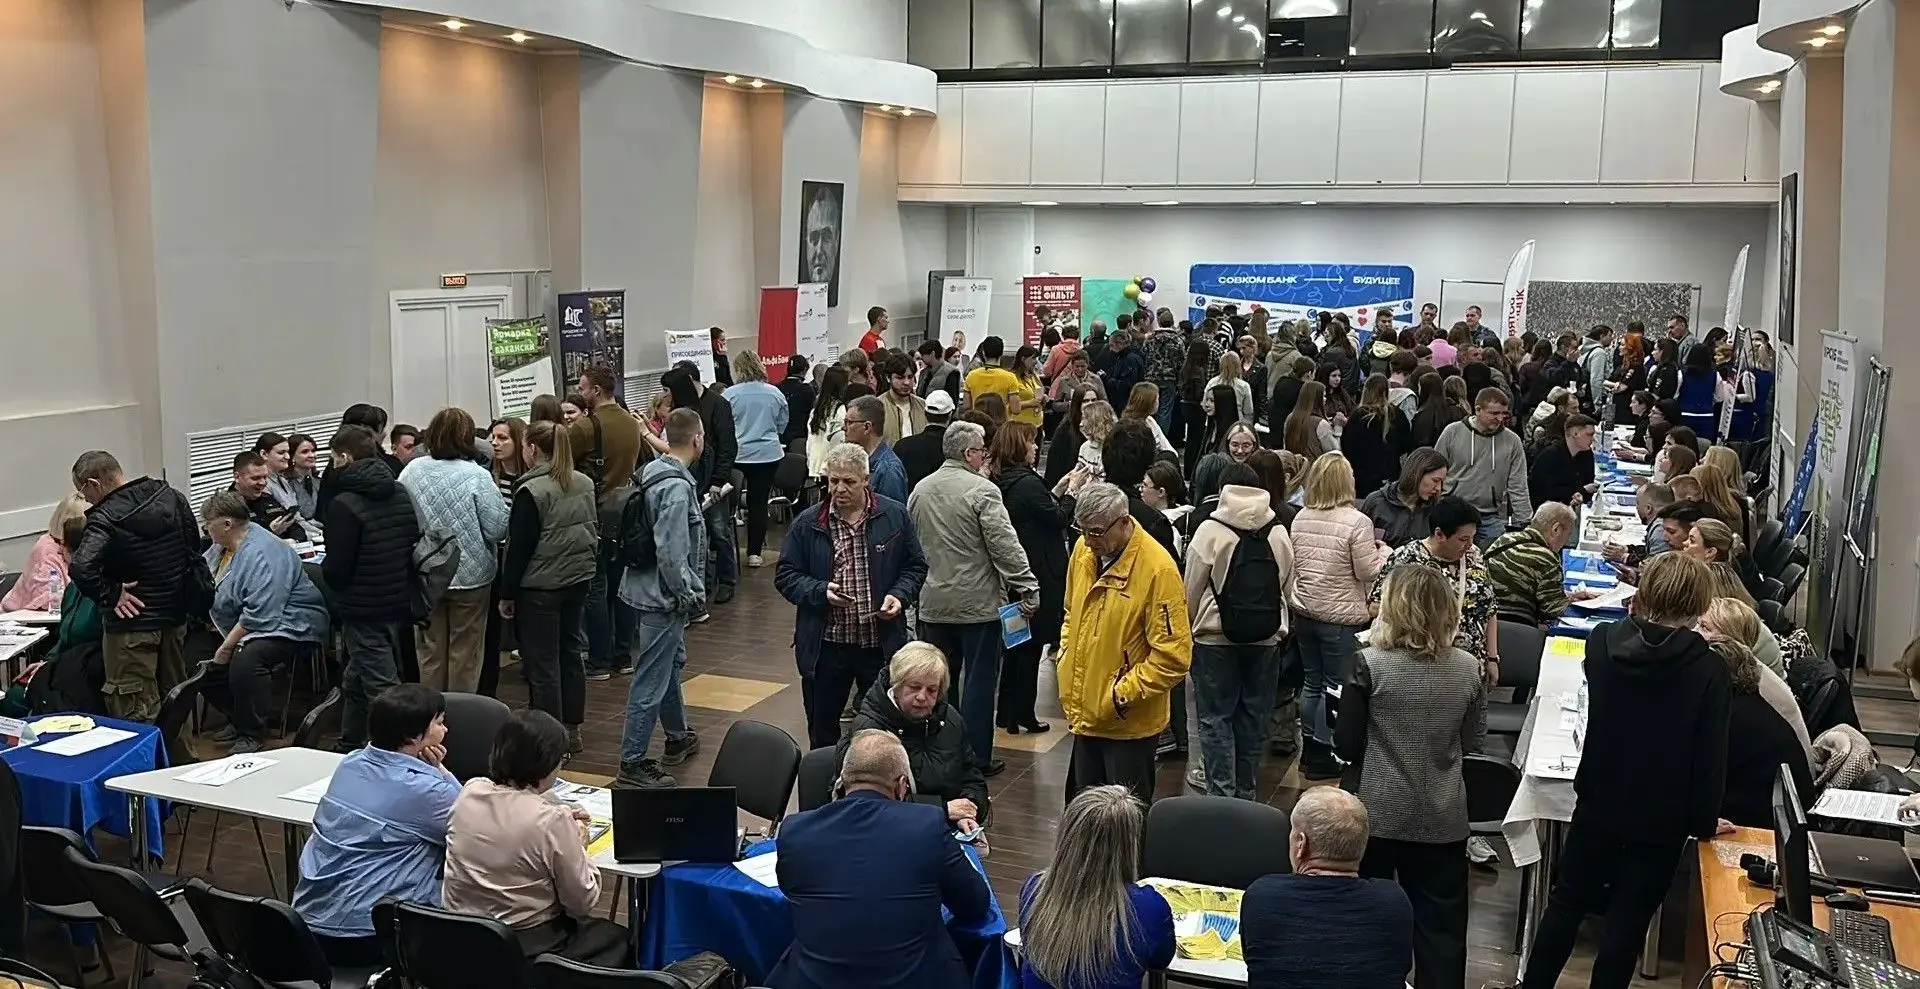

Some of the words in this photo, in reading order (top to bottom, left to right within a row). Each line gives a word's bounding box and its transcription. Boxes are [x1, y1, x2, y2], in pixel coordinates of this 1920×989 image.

[1218, 276, 1297, 284] СОВКОМБАНК
[1353, 276, 1400, 285] БУДУЩЕЕ
[1043, 291, 1075, 299] ФИЛЬТР
[493, 328, 532, 341] Ярмарка
[495, 339, 536, 354] вакансий
